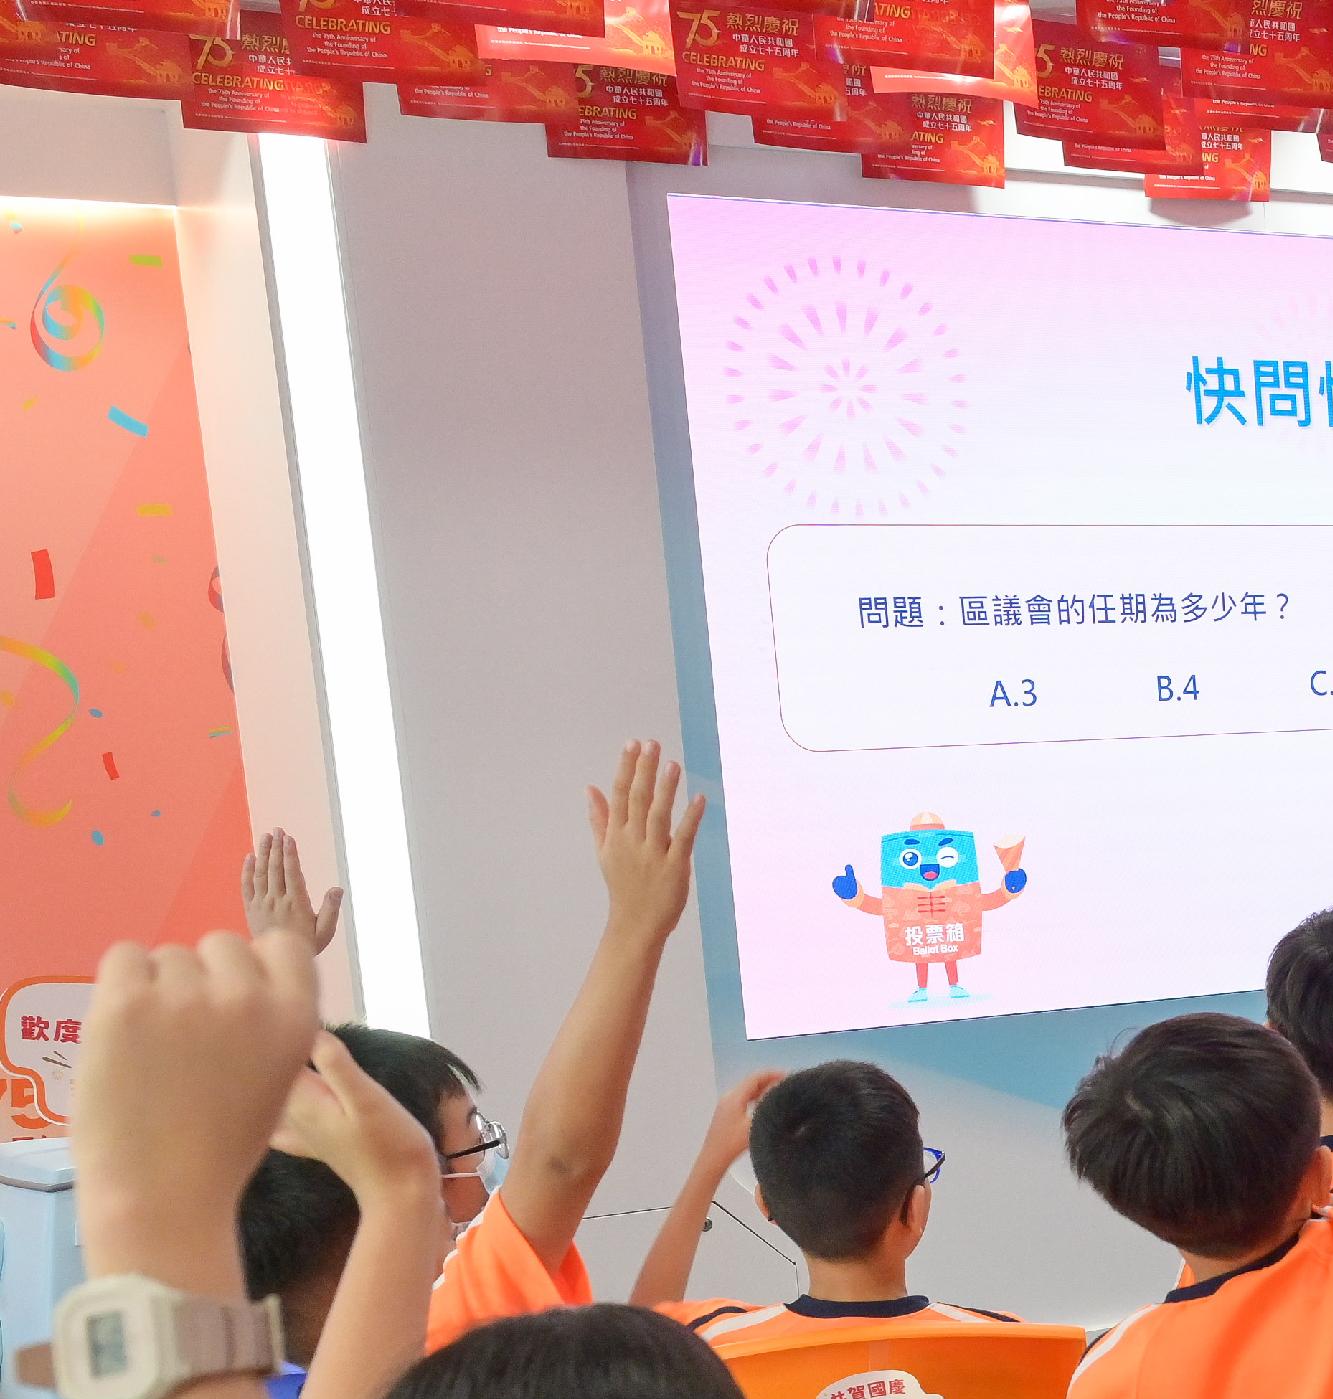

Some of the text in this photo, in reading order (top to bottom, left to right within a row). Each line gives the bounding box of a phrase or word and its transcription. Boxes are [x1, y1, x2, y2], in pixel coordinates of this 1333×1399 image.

[1252, 0, 1302, 19] 烈慶祝
[296, 15, 390, 34] CELEBRATING
[677, 10, 721, 50] 75
[727, 13, 799, 36] 熱烈慶祝
[1250, 18, 1295, 31] 人民共和國
[1250, 29, 1300, 42] 立七十五周年
[189, 34, 234, 69] 75
[683, 52, 765, 70] CELEBRATING
[1037, 44, 1055, 78] 5
[192, 73, 284, 90] CELEBRATING
[575, 65, 594, 98] 5
[1040, 86, 1092, 102] EBRATING
[579, 106, 637, 119] EBRATING
[858, 592, 1291, 629] 問題：區議會的任期為多少年？
[989, 679, 1039, 709] A.3
[1156, 674, 1200, 702] B.4
[905, 923, 965, 946] 投票箱
[912, 944, 958, 956] Ballot Box
[21, 1015, 82, 1044] 歡度
